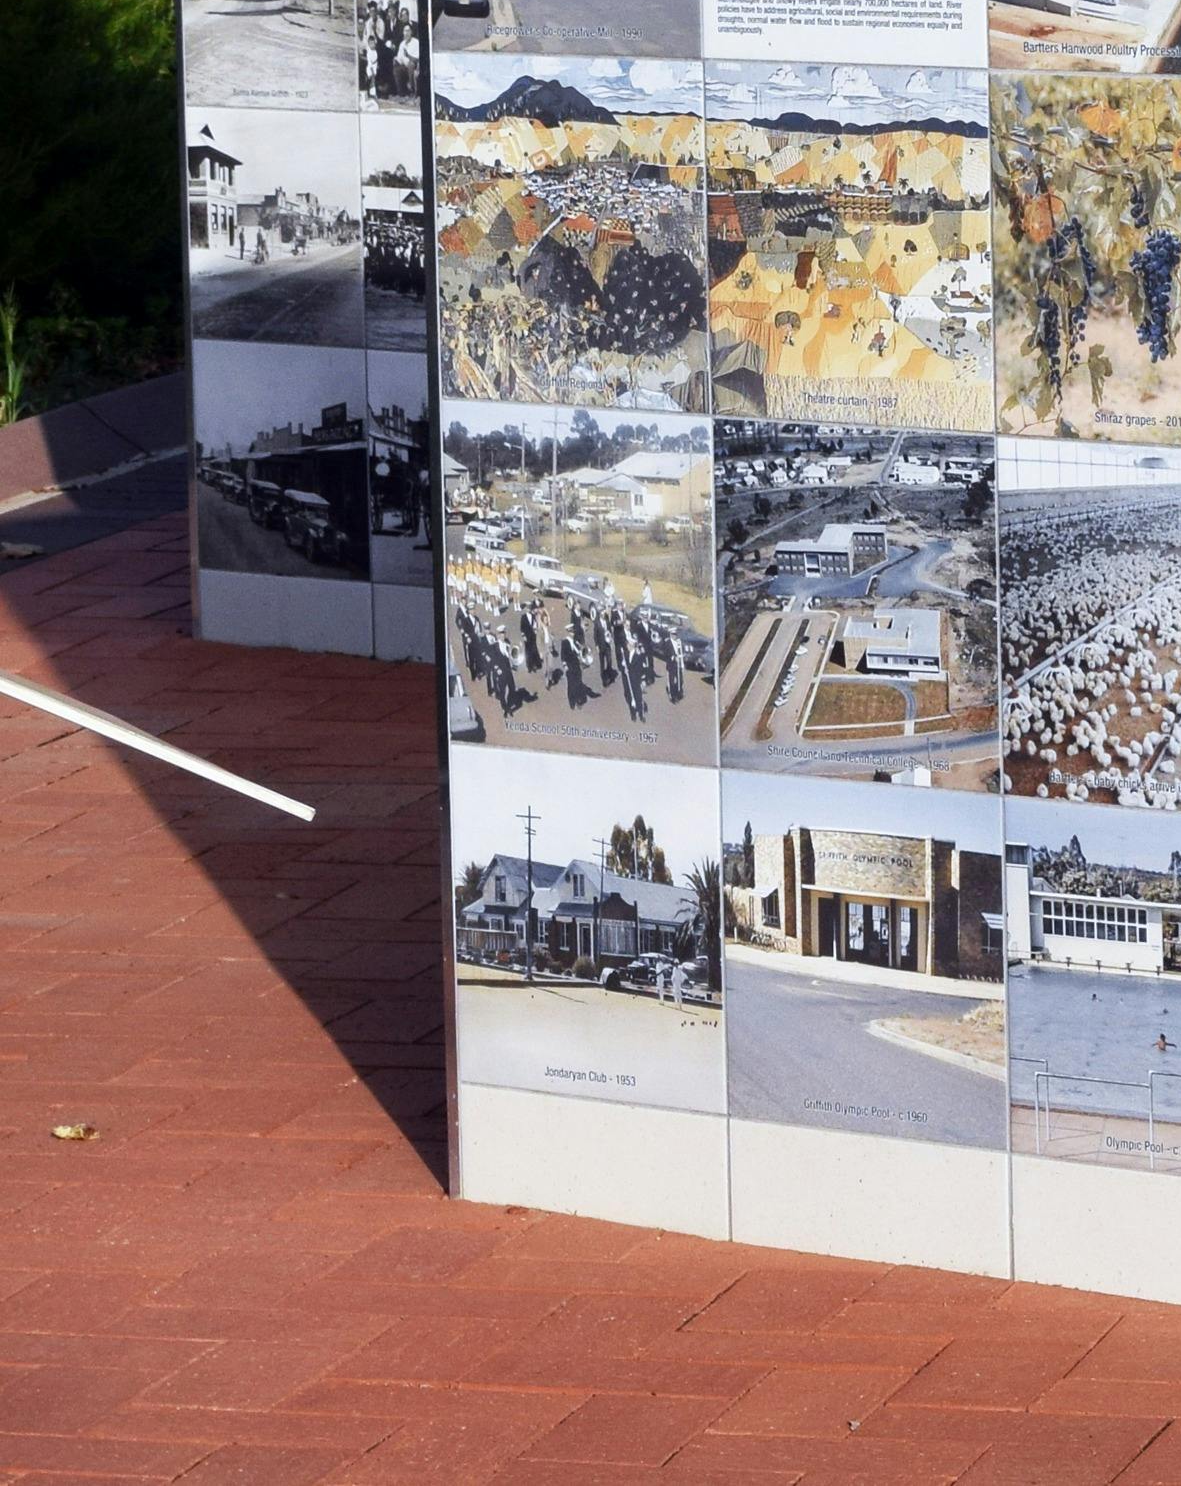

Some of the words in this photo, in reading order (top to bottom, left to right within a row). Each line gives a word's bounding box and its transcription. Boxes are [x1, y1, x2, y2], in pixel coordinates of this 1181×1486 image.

[543, 25, 595, 39] Co-operative
[622, 28, 643, 40] 1990
[1023, 42, 1059, 54] Bartters
[1062, 43, 1103, 55] Hanwood
[1106, 43, 1137, 58] Poultry
[540, 377, 569, 387] Griffith
[570, 377, 606, 391] Regional
[802, 392, 835, 405] Theatre
[837, 395, 868, 407] curtain
[878, 397, 898, 409] 1987
[1094, 411, 1122, 425] Shiraz
[1125, 415, 1156, 427] grapes
[505, 722, 529, 733] Yenda
[531, 723, 559, 735] School
[561, 725, 579, 736] 50th
[581, 726, 629, 742] anniversary
[639, 732, 659, 743] 1967
[767, 745, 790, 757] Shire
[792, 747, 822, 760] Council
[844, 752, 885, 766] Technical
[887, 756, 919, 770] College
[1094, 775, 1115, 790] baby
[1118, 777, 1147, 791] chicks
[1149, 781, 1175, 793] arrive
[853, 854, 886, 865] OLYMPIC
[890, 856, 913, 868] POOL
[545, 1066, 587, 1081] Jondaryan
[589, 1071, 607, 1083] Club
[616, 1075, 636, 1087] 1953
[804, 1098, 832, 1111] Griffith
[834, 1102, 869, 1118] Olympic
[871, 1106, 890, 1119] Pool
[906, 1111, 928, 1123] 1960
[1106, 1136, 1142, 1152] Olympic
[1144, 1140, 1164, 1153] Pool
